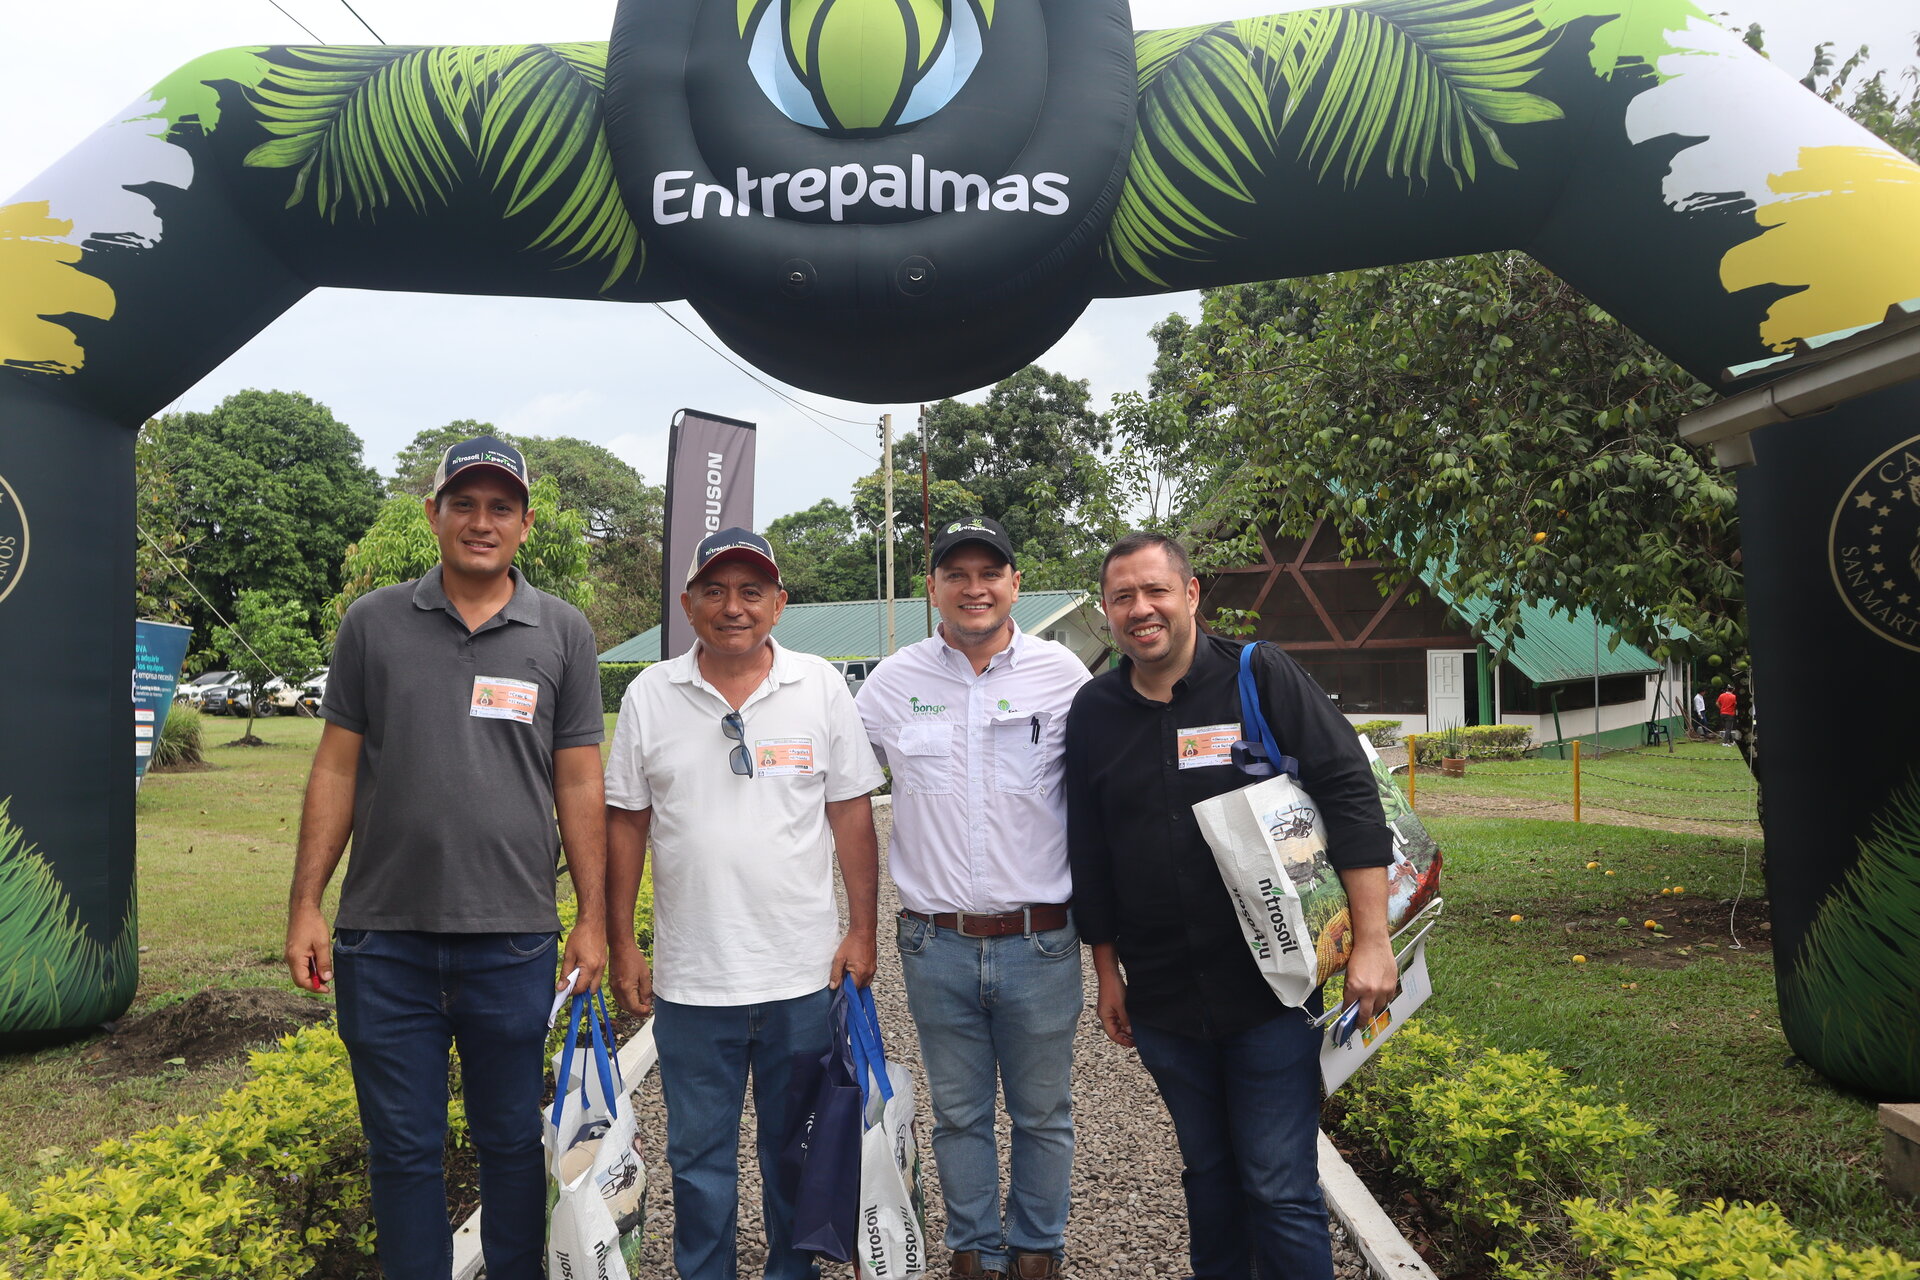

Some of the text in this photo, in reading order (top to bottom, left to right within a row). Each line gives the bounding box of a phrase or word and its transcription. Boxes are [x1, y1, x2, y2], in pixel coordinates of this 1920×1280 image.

[652, 153, 1071, 226] Entrepalmas
[1879, 451, 1920, 483] CA
[1841, 546, 1920, 636] SAN MART
[913, 701, 946, 714] bongo
[1258, 878, 1299, 955] nitrosoil
[556, 1250, 574, 1280] soil
[593, 1240, 612, 1280] nitro
[864, 1204, 888, 1276] nitrosoil
[899, 1205, 922, 1274] nitrosoil
